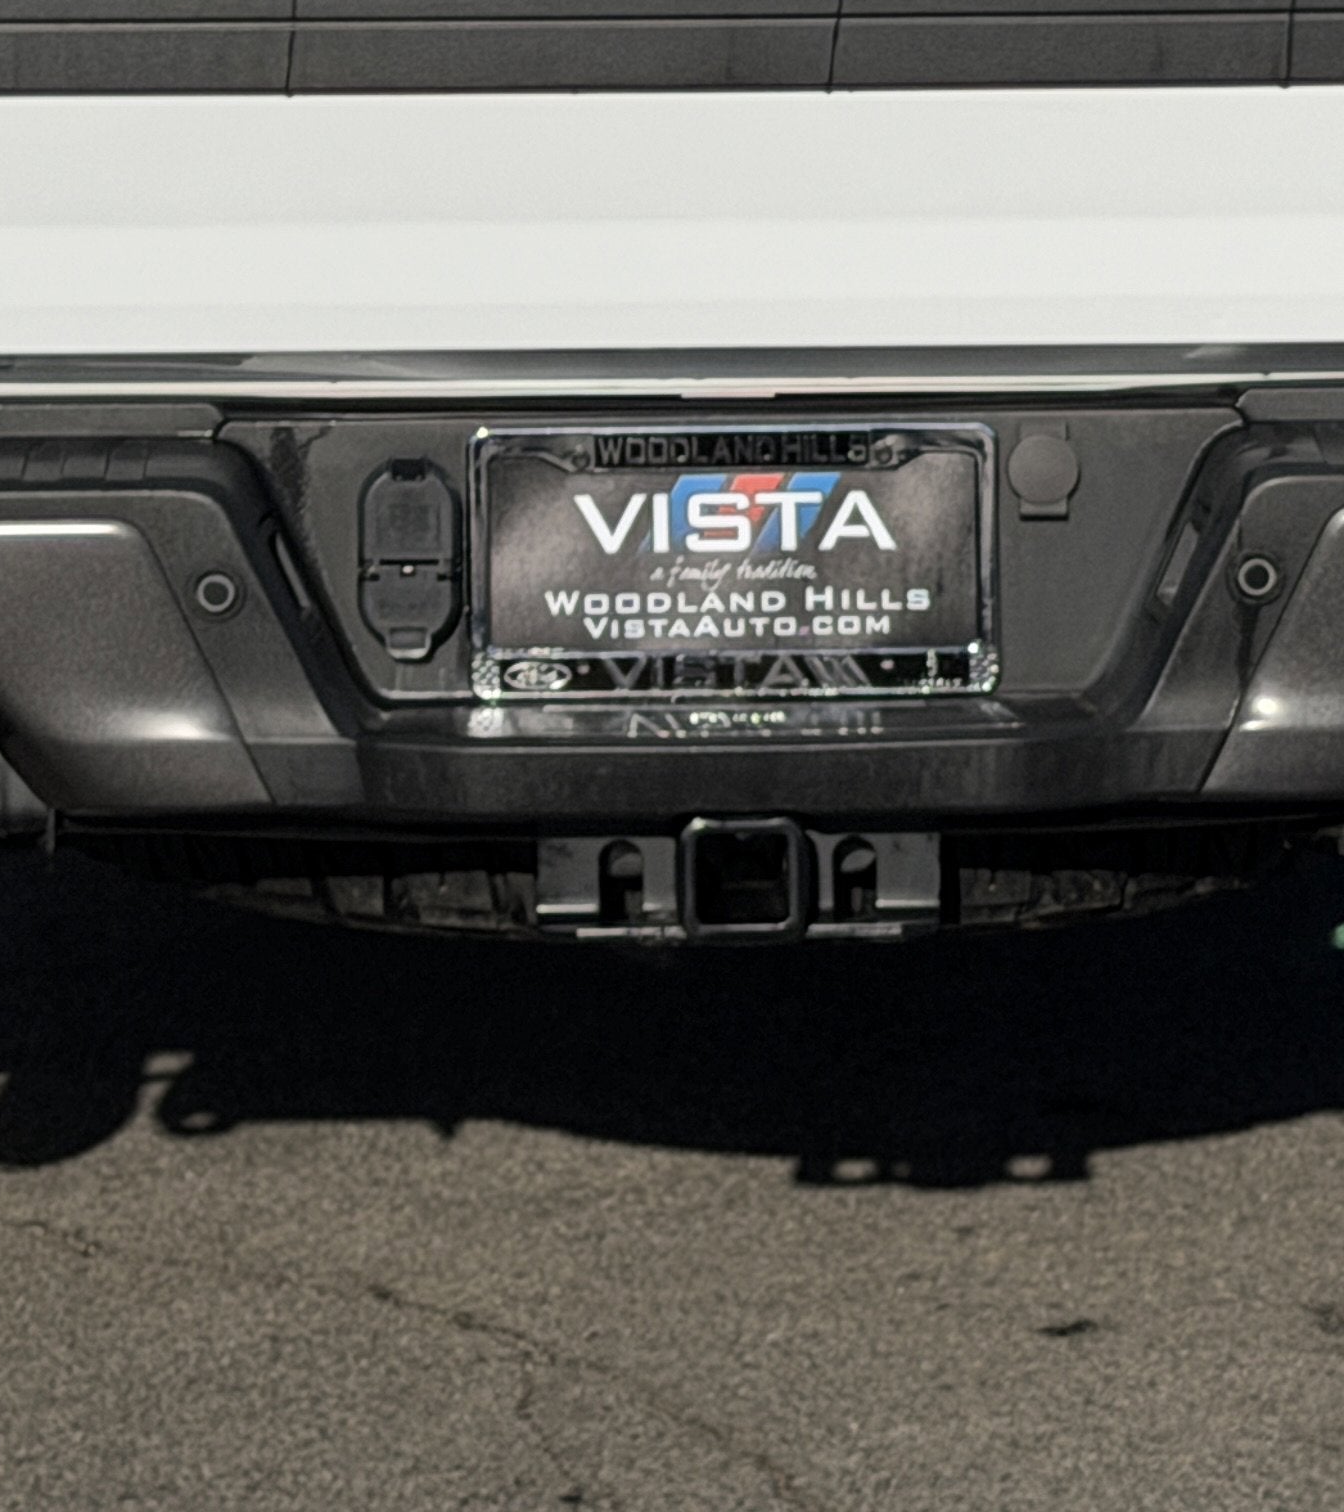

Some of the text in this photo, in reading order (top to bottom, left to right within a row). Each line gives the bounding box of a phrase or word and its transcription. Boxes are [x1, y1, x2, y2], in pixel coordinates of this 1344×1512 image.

[596, 432, 868, 466] WOODLAND HILLS
[573, 490, 898, 555] VISTA
